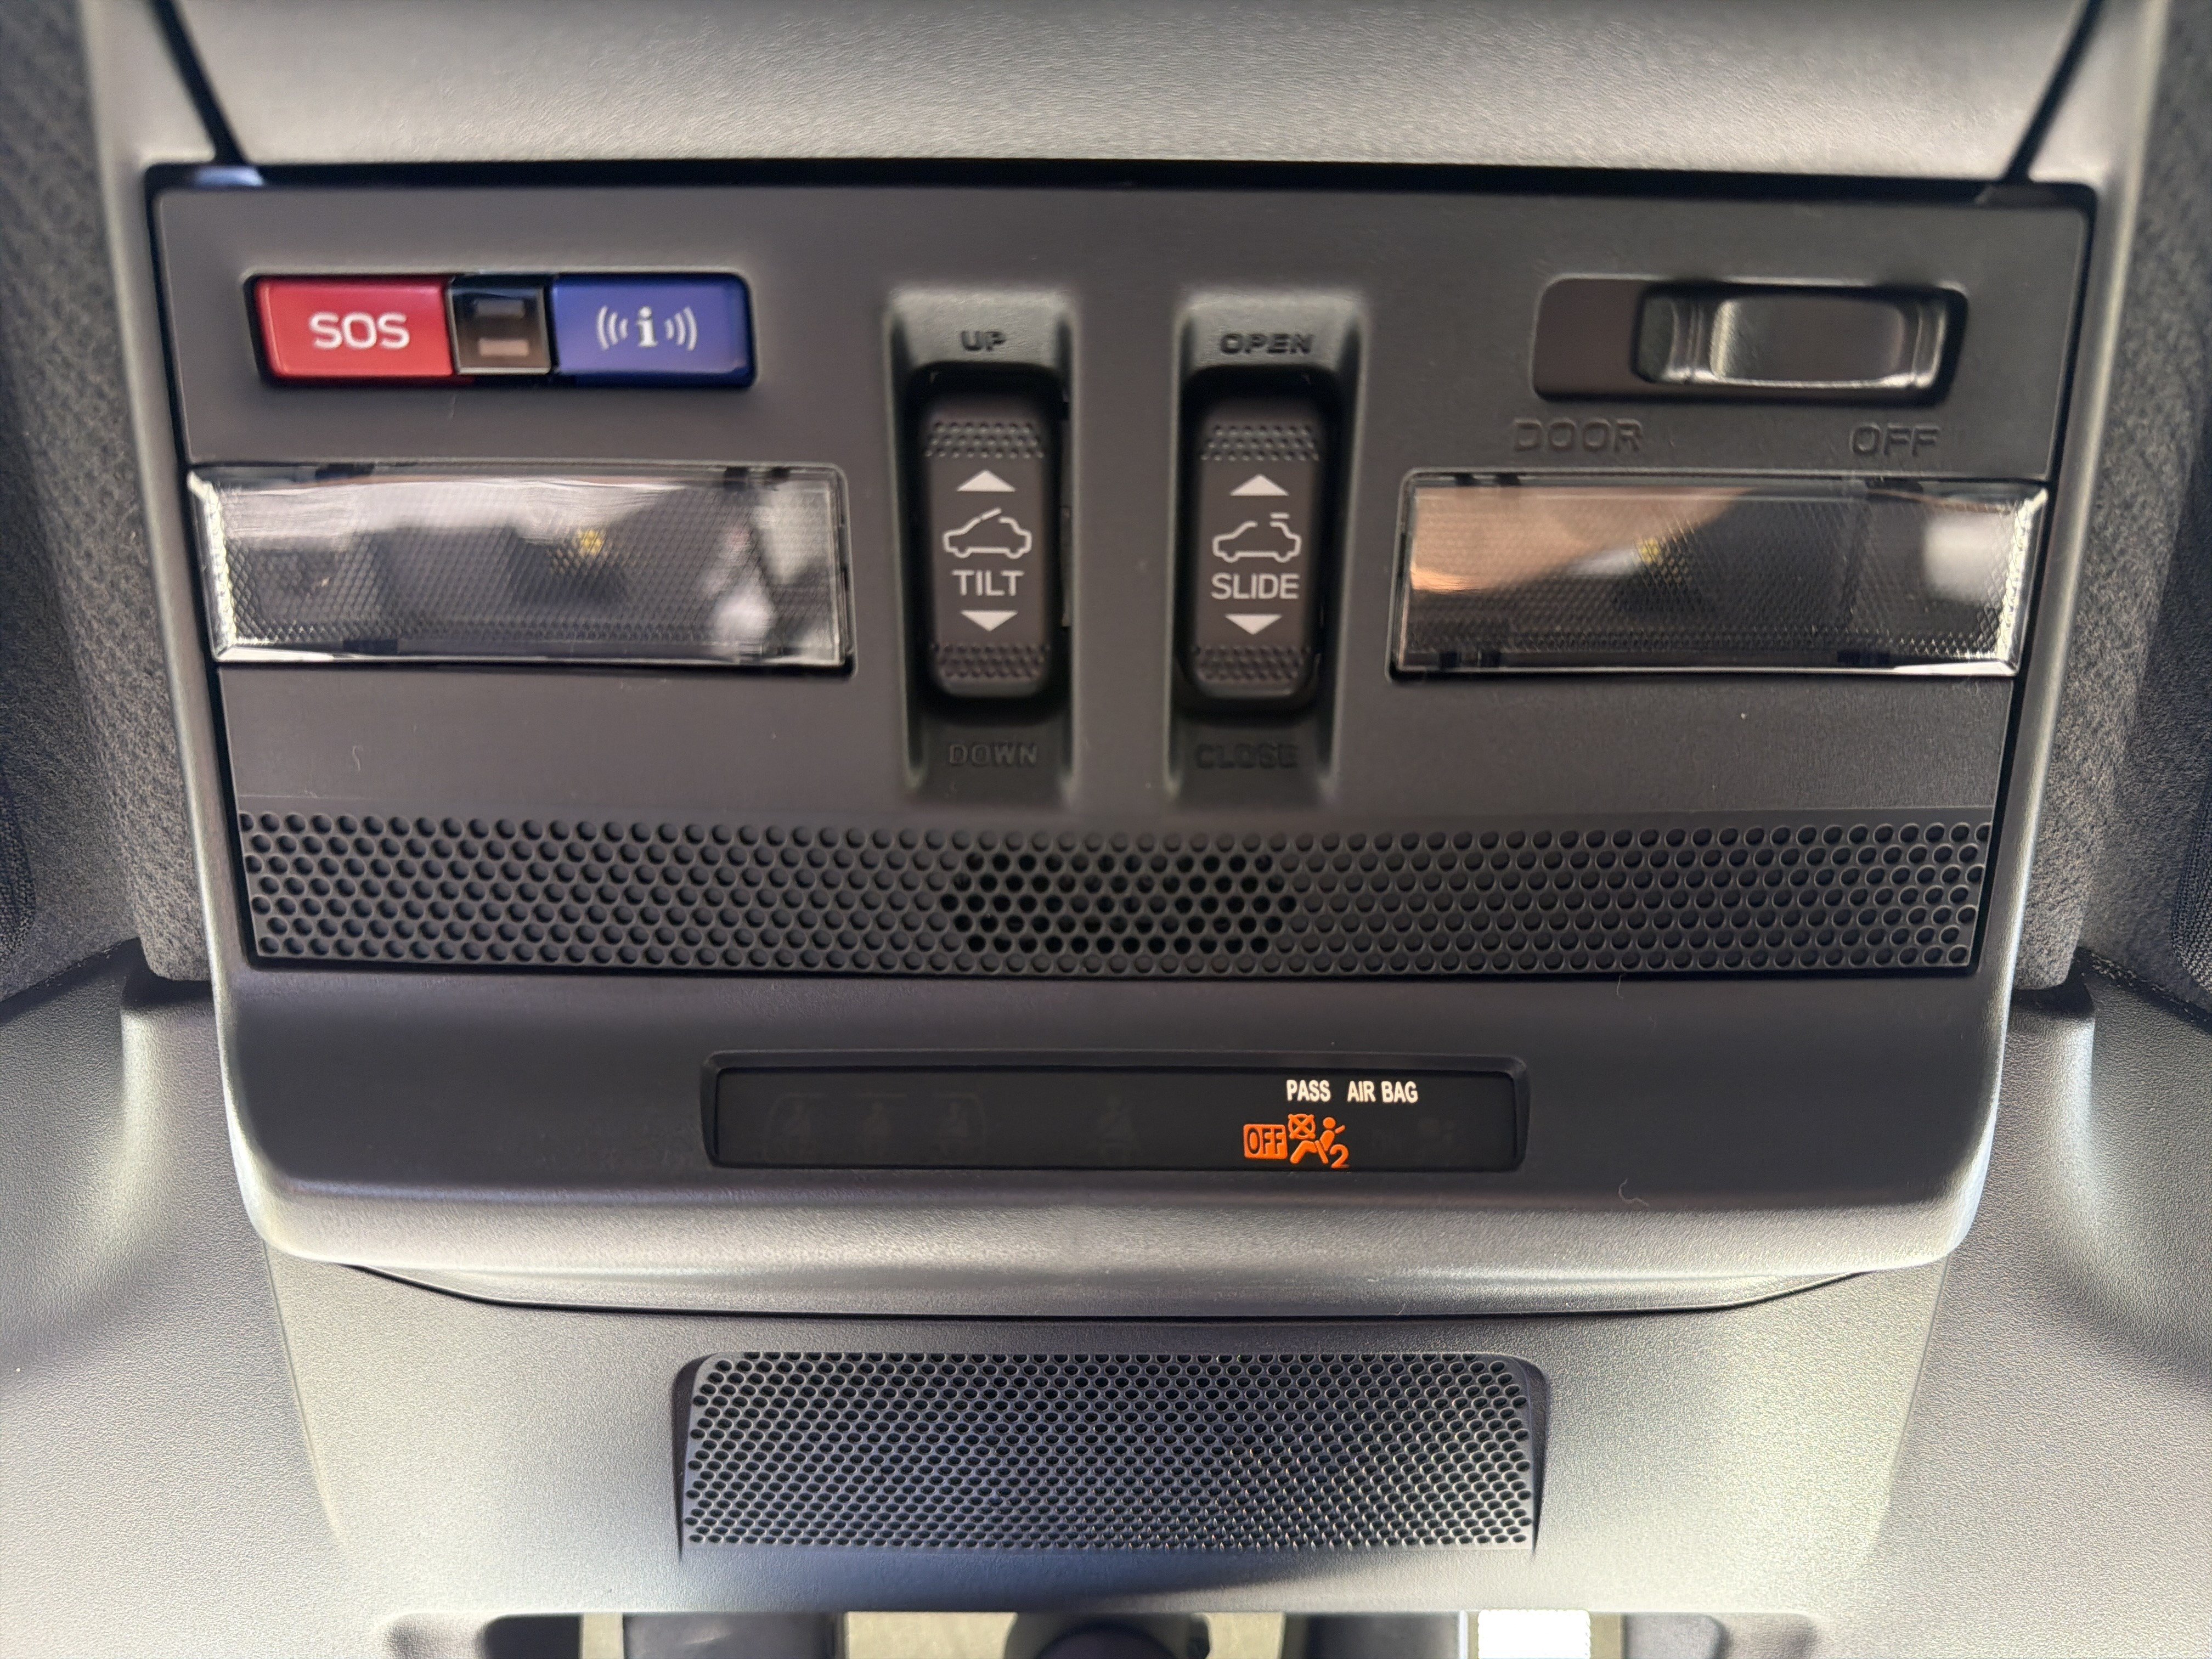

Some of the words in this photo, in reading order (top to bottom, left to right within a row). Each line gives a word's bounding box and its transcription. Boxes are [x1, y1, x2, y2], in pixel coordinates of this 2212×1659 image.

[309, 312, 410, 350] SOS
[961, 330, 1007, 352] UP
[1220, 332, 1313, 355] OPEN
[1513, 417, 1643, 453] DOOR
[1851, 422, 1941, 456] OFF
[952, 570, 1024, 596] TILT
[1211, 573, 1300, 600] SLIDE
[949, 743, 1038, 767] DOWN
[1195, 743, 1299, 769] CLOSE
[1286, 1080, 1331, 1102] PASS
[1347, 1081, 1376, 1103] AIR
[1381, 1081, 1419, 1104] BAG
[1248, 1127, 1285, 1154] OFF
